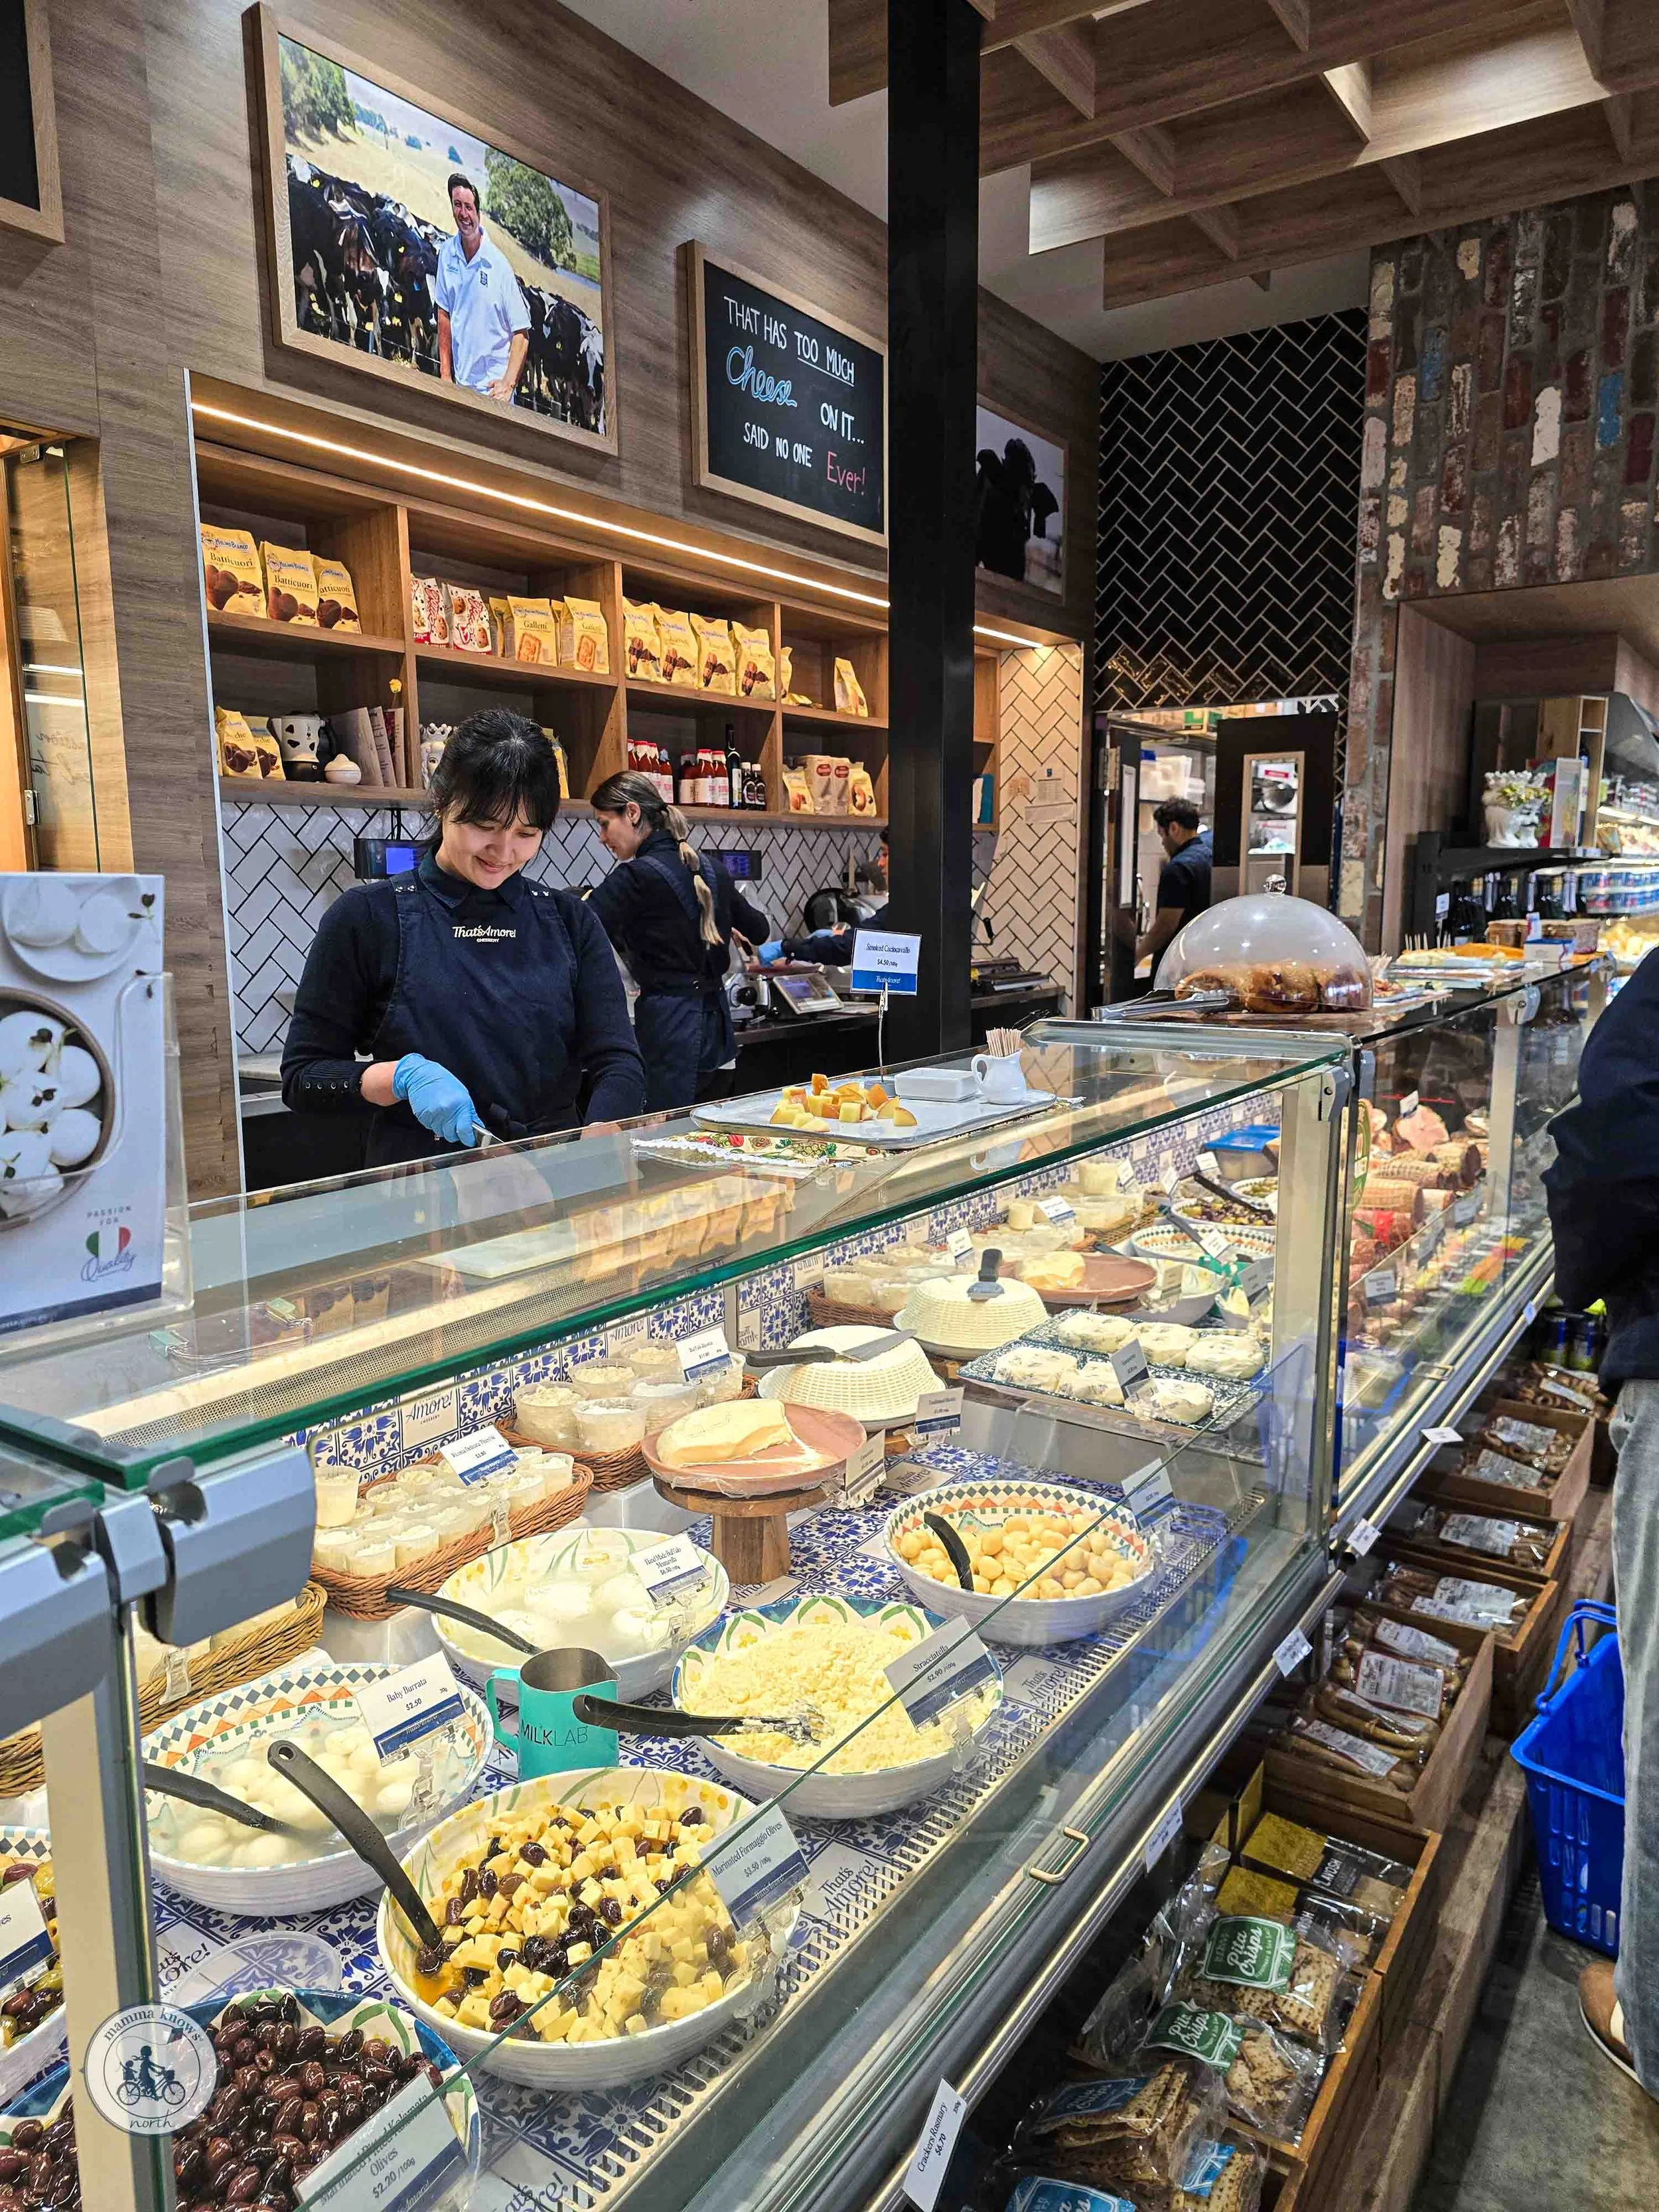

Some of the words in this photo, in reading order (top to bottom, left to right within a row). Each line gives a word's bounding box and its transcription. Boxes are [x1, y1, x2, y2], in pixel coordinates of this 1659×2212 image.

[723, 296, 760, 334] THAT
[764, 317, 787, 349] HAS
[794, 331, 818, 363] TOO
[827, 346, 855, 384] MUCH
[727, 346, 797, 407] Cheese
[820, 403, 838, 431] ON
[743, 421, 769, 450] SAID
[776, 437, 789, 460] NO
[793, 443, 813, 468] ONE
[827, 451, 865, 496] Ever!
[210, 552, 253, 567] Batticuori
[274, 574, 313, 590] Batticuori
[319, 585, 350, 594] atticuori
[524, 619, 547, 630] Galletti
[452, 925, 483, 938] That's
[866, 943, 884, 952] Smoked
[80, 1249, 137, 1282] Quality
[405, 1390, 453, 1424] Amore!
[912, 1645, 949, 1672] Stracciatella
[927, 1668, 943, 1682] $2.90
[1028, 1666, 1067, 1704] Amore!
[386, 1690, 404, 1703] Baby
[403, 1678, 427, 1694] Burrata
[405, 1698, 422, 1711] $2.50
[521, 1719, 589, 1747] MILKLAB
[711, 1846, 741, 1878] Marinated
[739, 1831, 767, 1858] Formaggio
[765, 1821, 783, 1839] Olives
[744, 1863, 760, 1878] $3.50
[818, 1867, 853, 1895] That's
[824, 1860, 879, 1919] Amore!
[1227, 1930, 1248, 1966] Pita
[1239, 1926, 1263, 1977] Crisps
[159, 1942, 210, 1987] ore!
[1181, 2013, 1210, 2049] Crisps
[917, 2134, 935, 2172] Crackers
[935, 2134, 946, 2156] $6.70
[370, 2148, 399, 2177] Olives
[372, 2172, 397, 2199] $2.20
[397, 2158, 416, 2179] /100g
